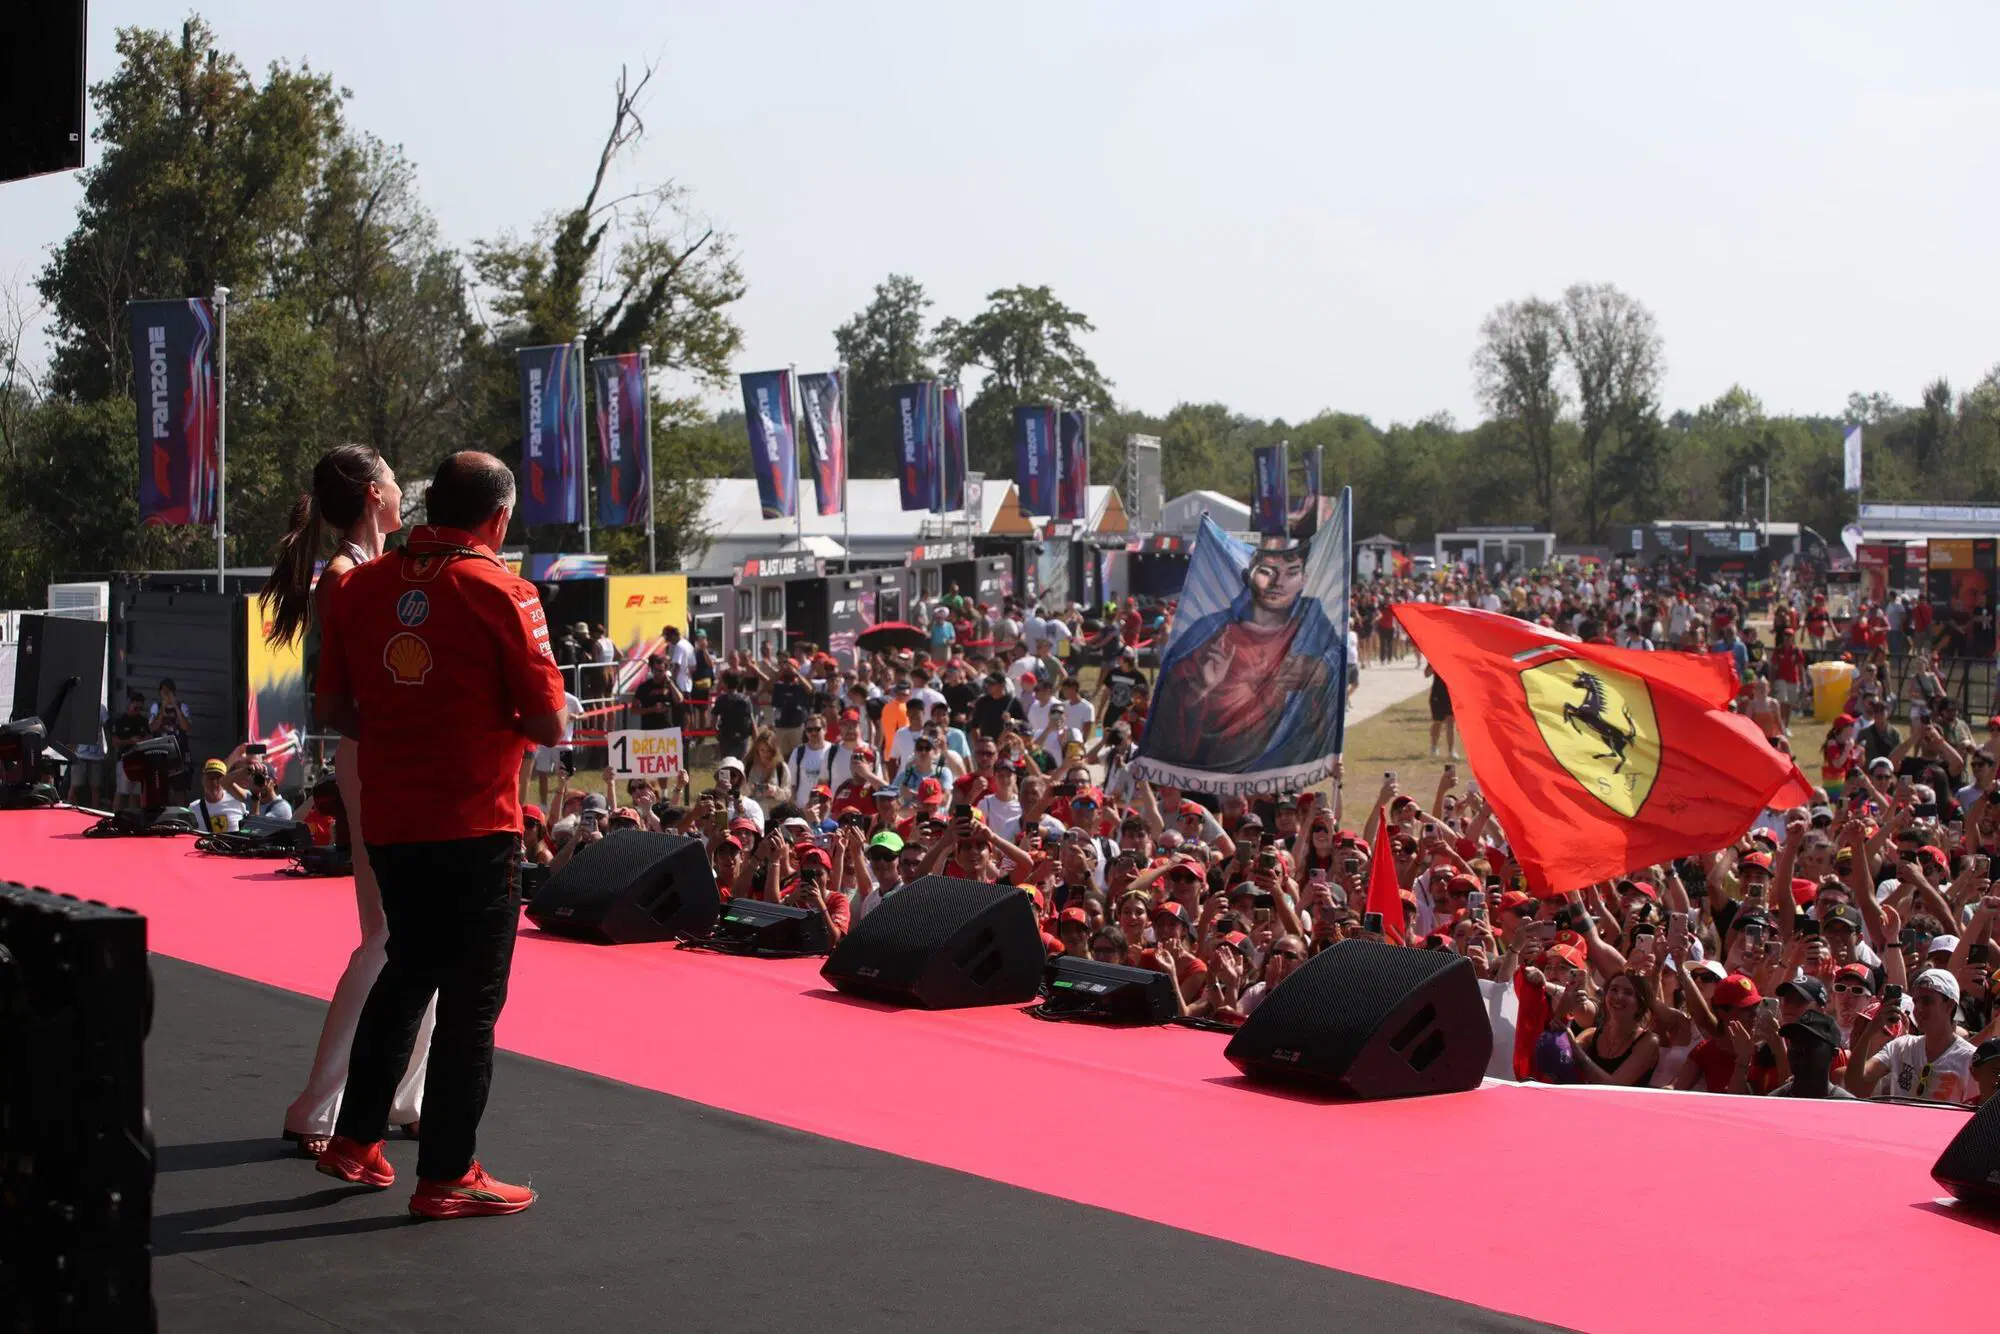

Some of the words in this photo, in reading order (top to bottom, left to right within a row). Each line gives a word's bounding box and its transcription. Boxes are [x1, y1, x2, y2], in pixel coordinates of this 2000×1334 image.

[613, 735, 632, 773] 1
[632, 737, 677, 754] DREAM
[636, 754, 679, 773] TEAM
